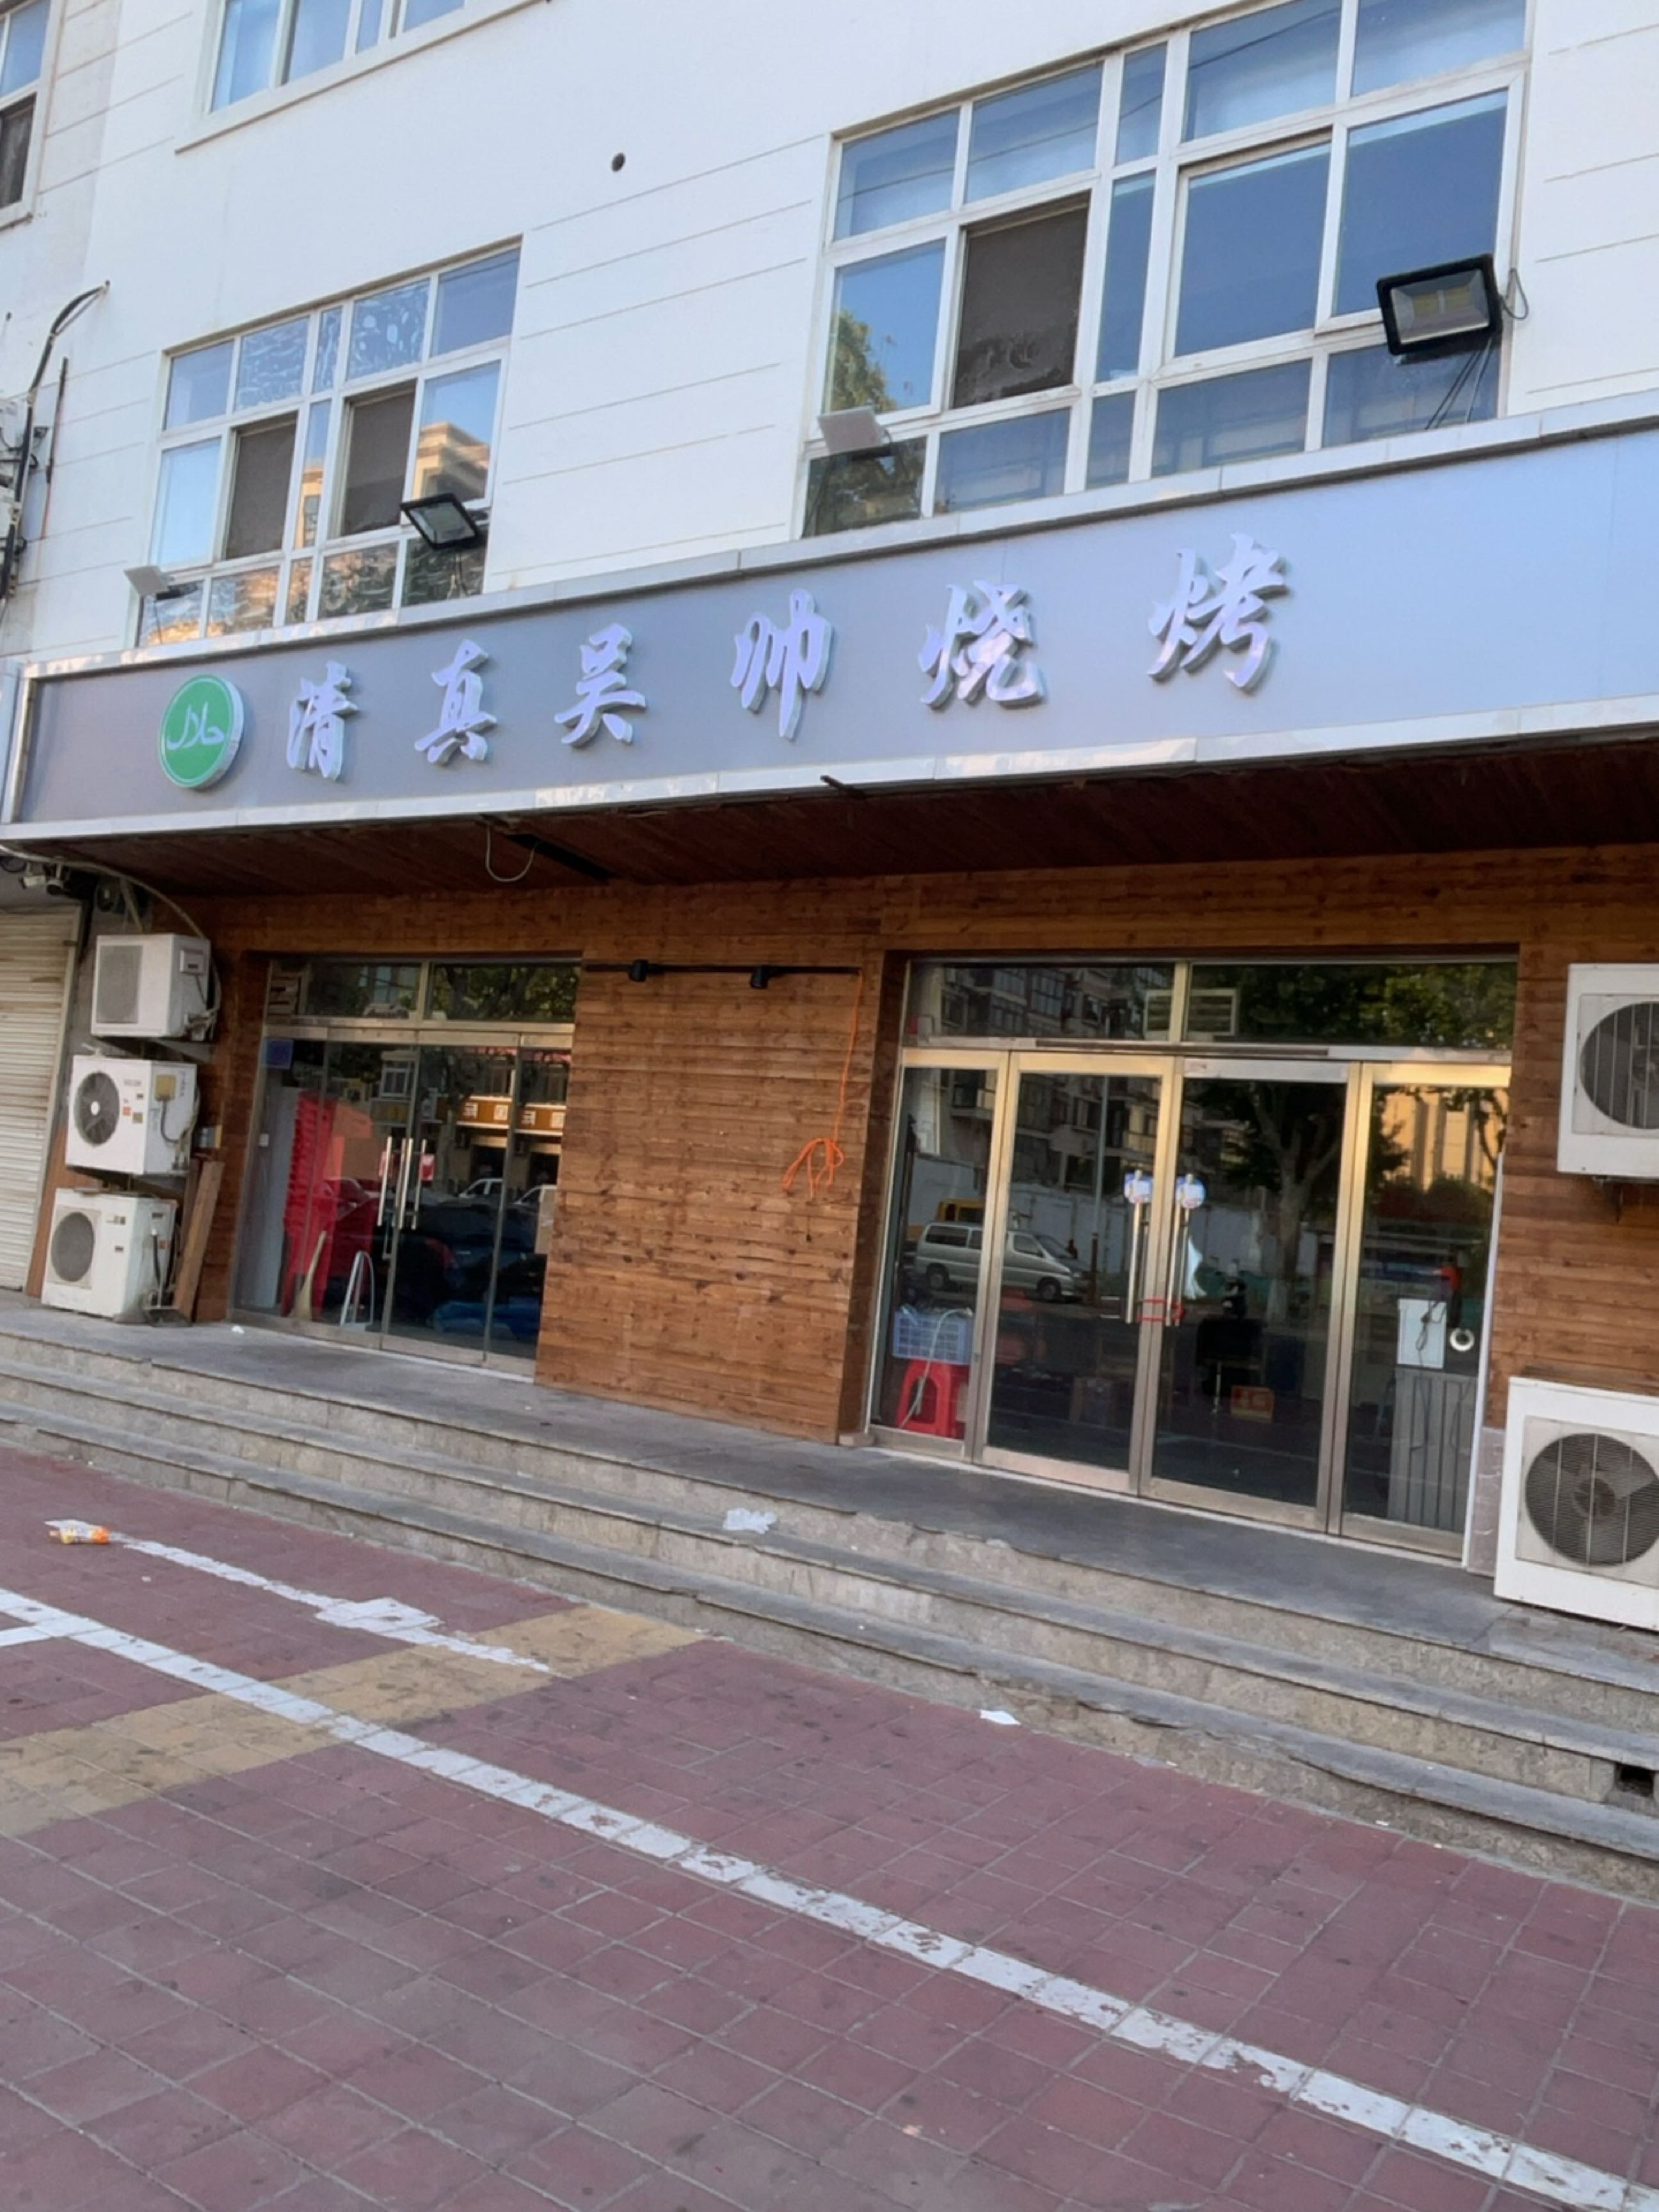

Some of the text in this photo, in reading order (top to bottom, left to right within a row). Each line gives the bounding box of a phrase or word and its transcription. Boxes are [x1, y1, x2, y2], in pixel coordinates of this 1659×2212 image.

[286, 533, 1287, 780] 清真吴帅烧烤
